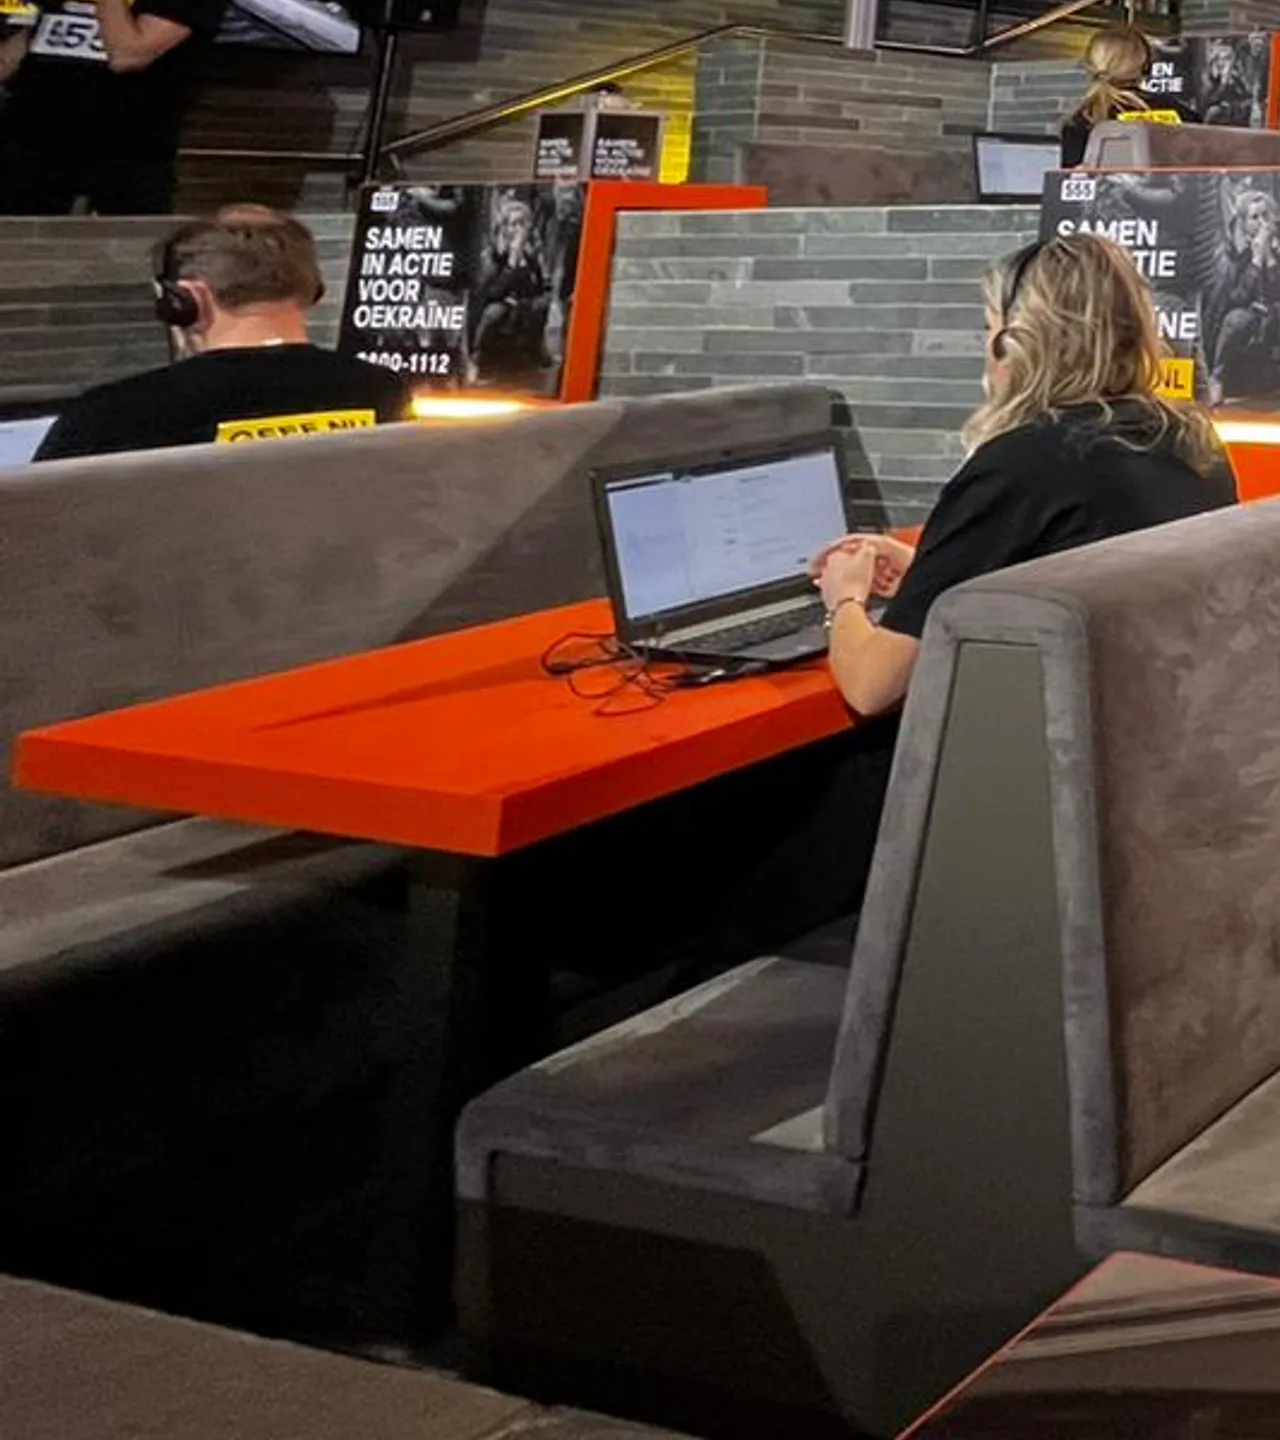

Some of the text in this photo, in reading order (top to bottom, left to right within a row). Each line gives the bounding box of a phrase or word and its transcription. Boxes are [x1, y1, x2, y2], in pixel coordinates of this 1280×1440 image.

[364, 226, 443, 250] SAMEN
[361, 252, 453, 277] IN ACTIE
[358, 279, 420, 302] VOOR
[353, 299, 466, 330] OEKRAÏNE
